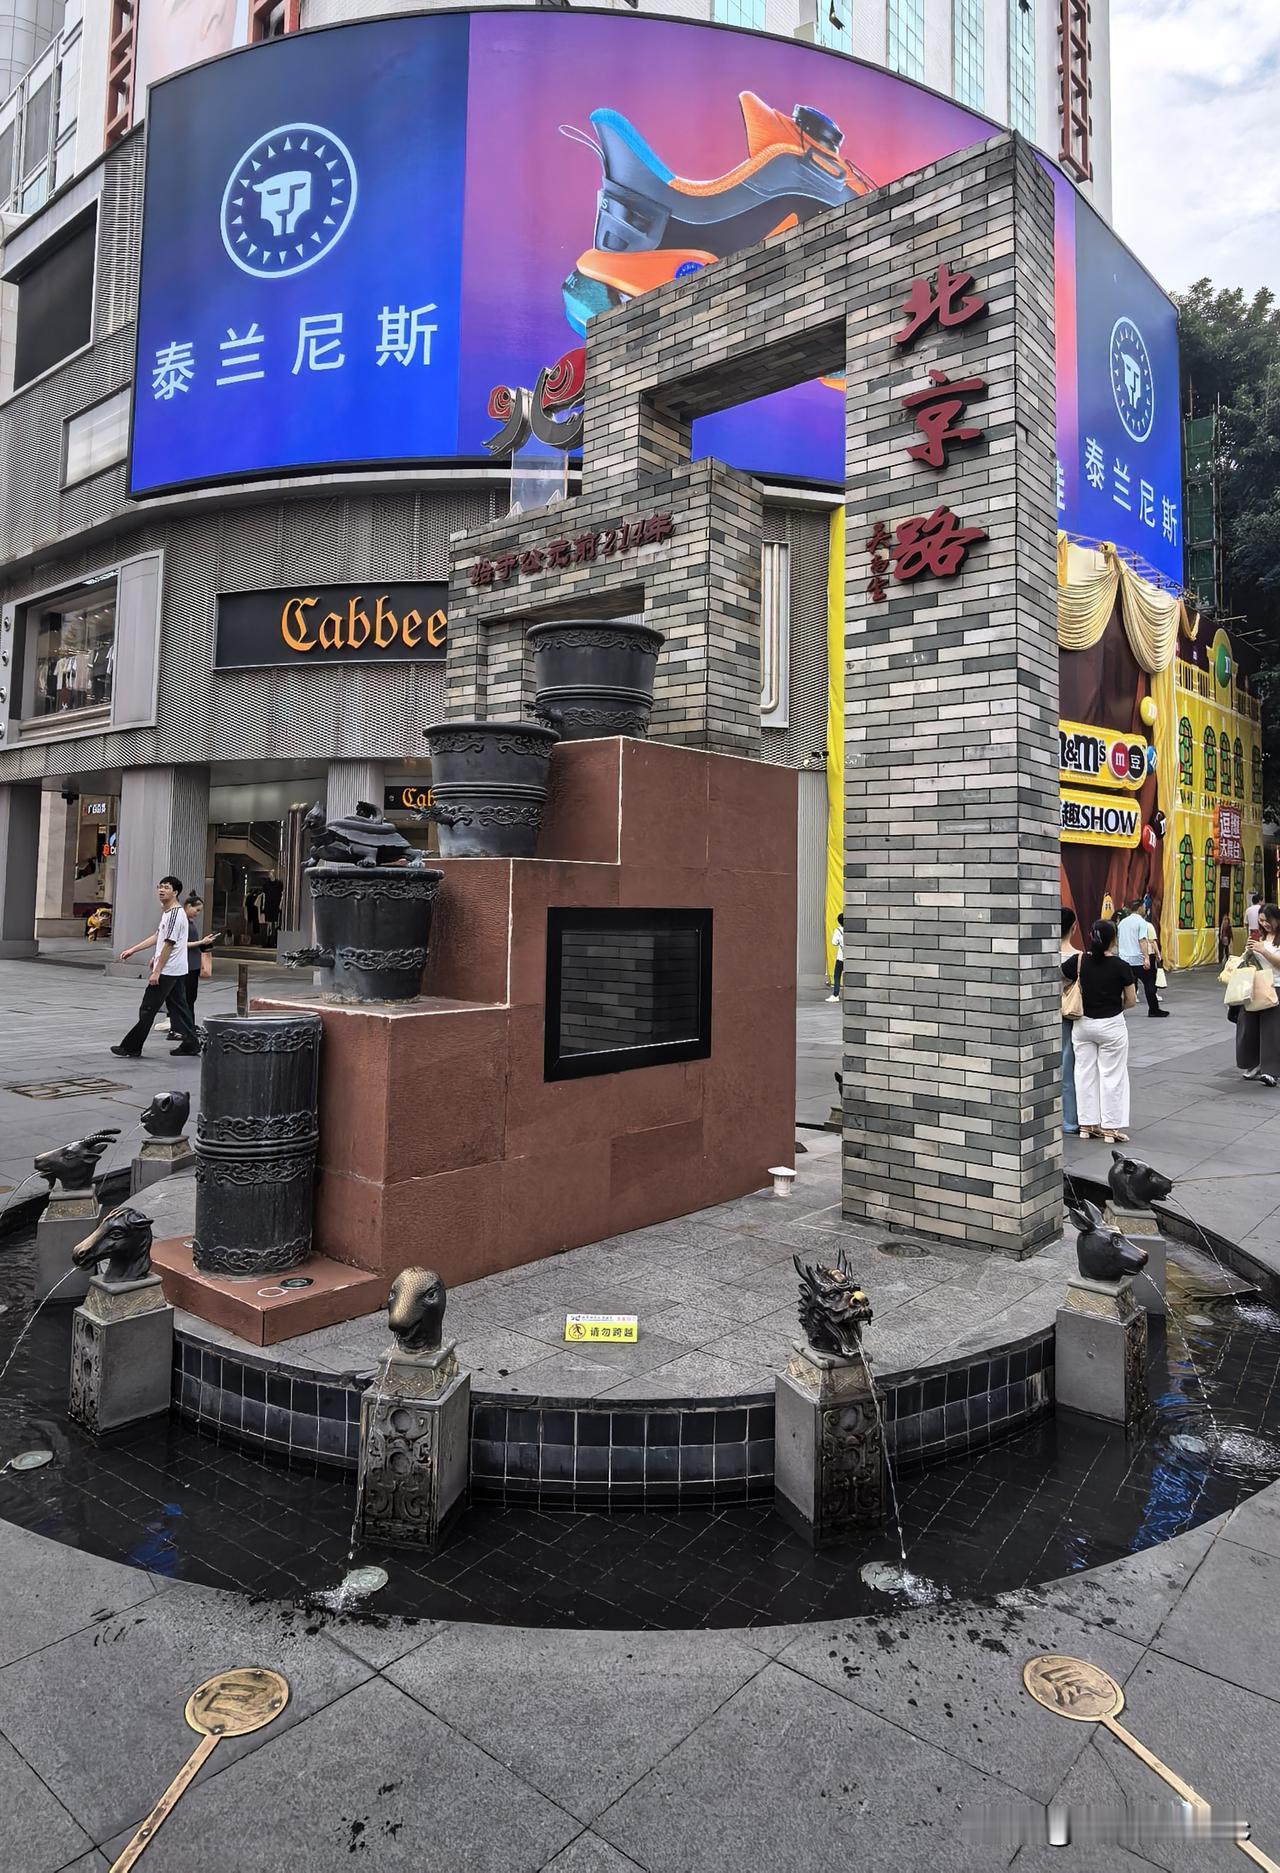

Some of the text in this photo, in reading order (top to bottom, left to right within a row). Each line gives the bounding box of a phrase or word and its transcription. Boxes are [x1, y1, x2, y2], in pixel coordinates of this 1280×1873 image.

[151, 303, 438, 401] 泰兰尼斯
[893, 262, 987, 581] 北京路
[1084, 437, 1178, 547] 泰兰尼斯
[470, 512, 675, 586] 始于公元前214年
[1060, 800, 1139, 835] 趣SHOW
[590, 1326, 634, 1338] 请勿跨越
